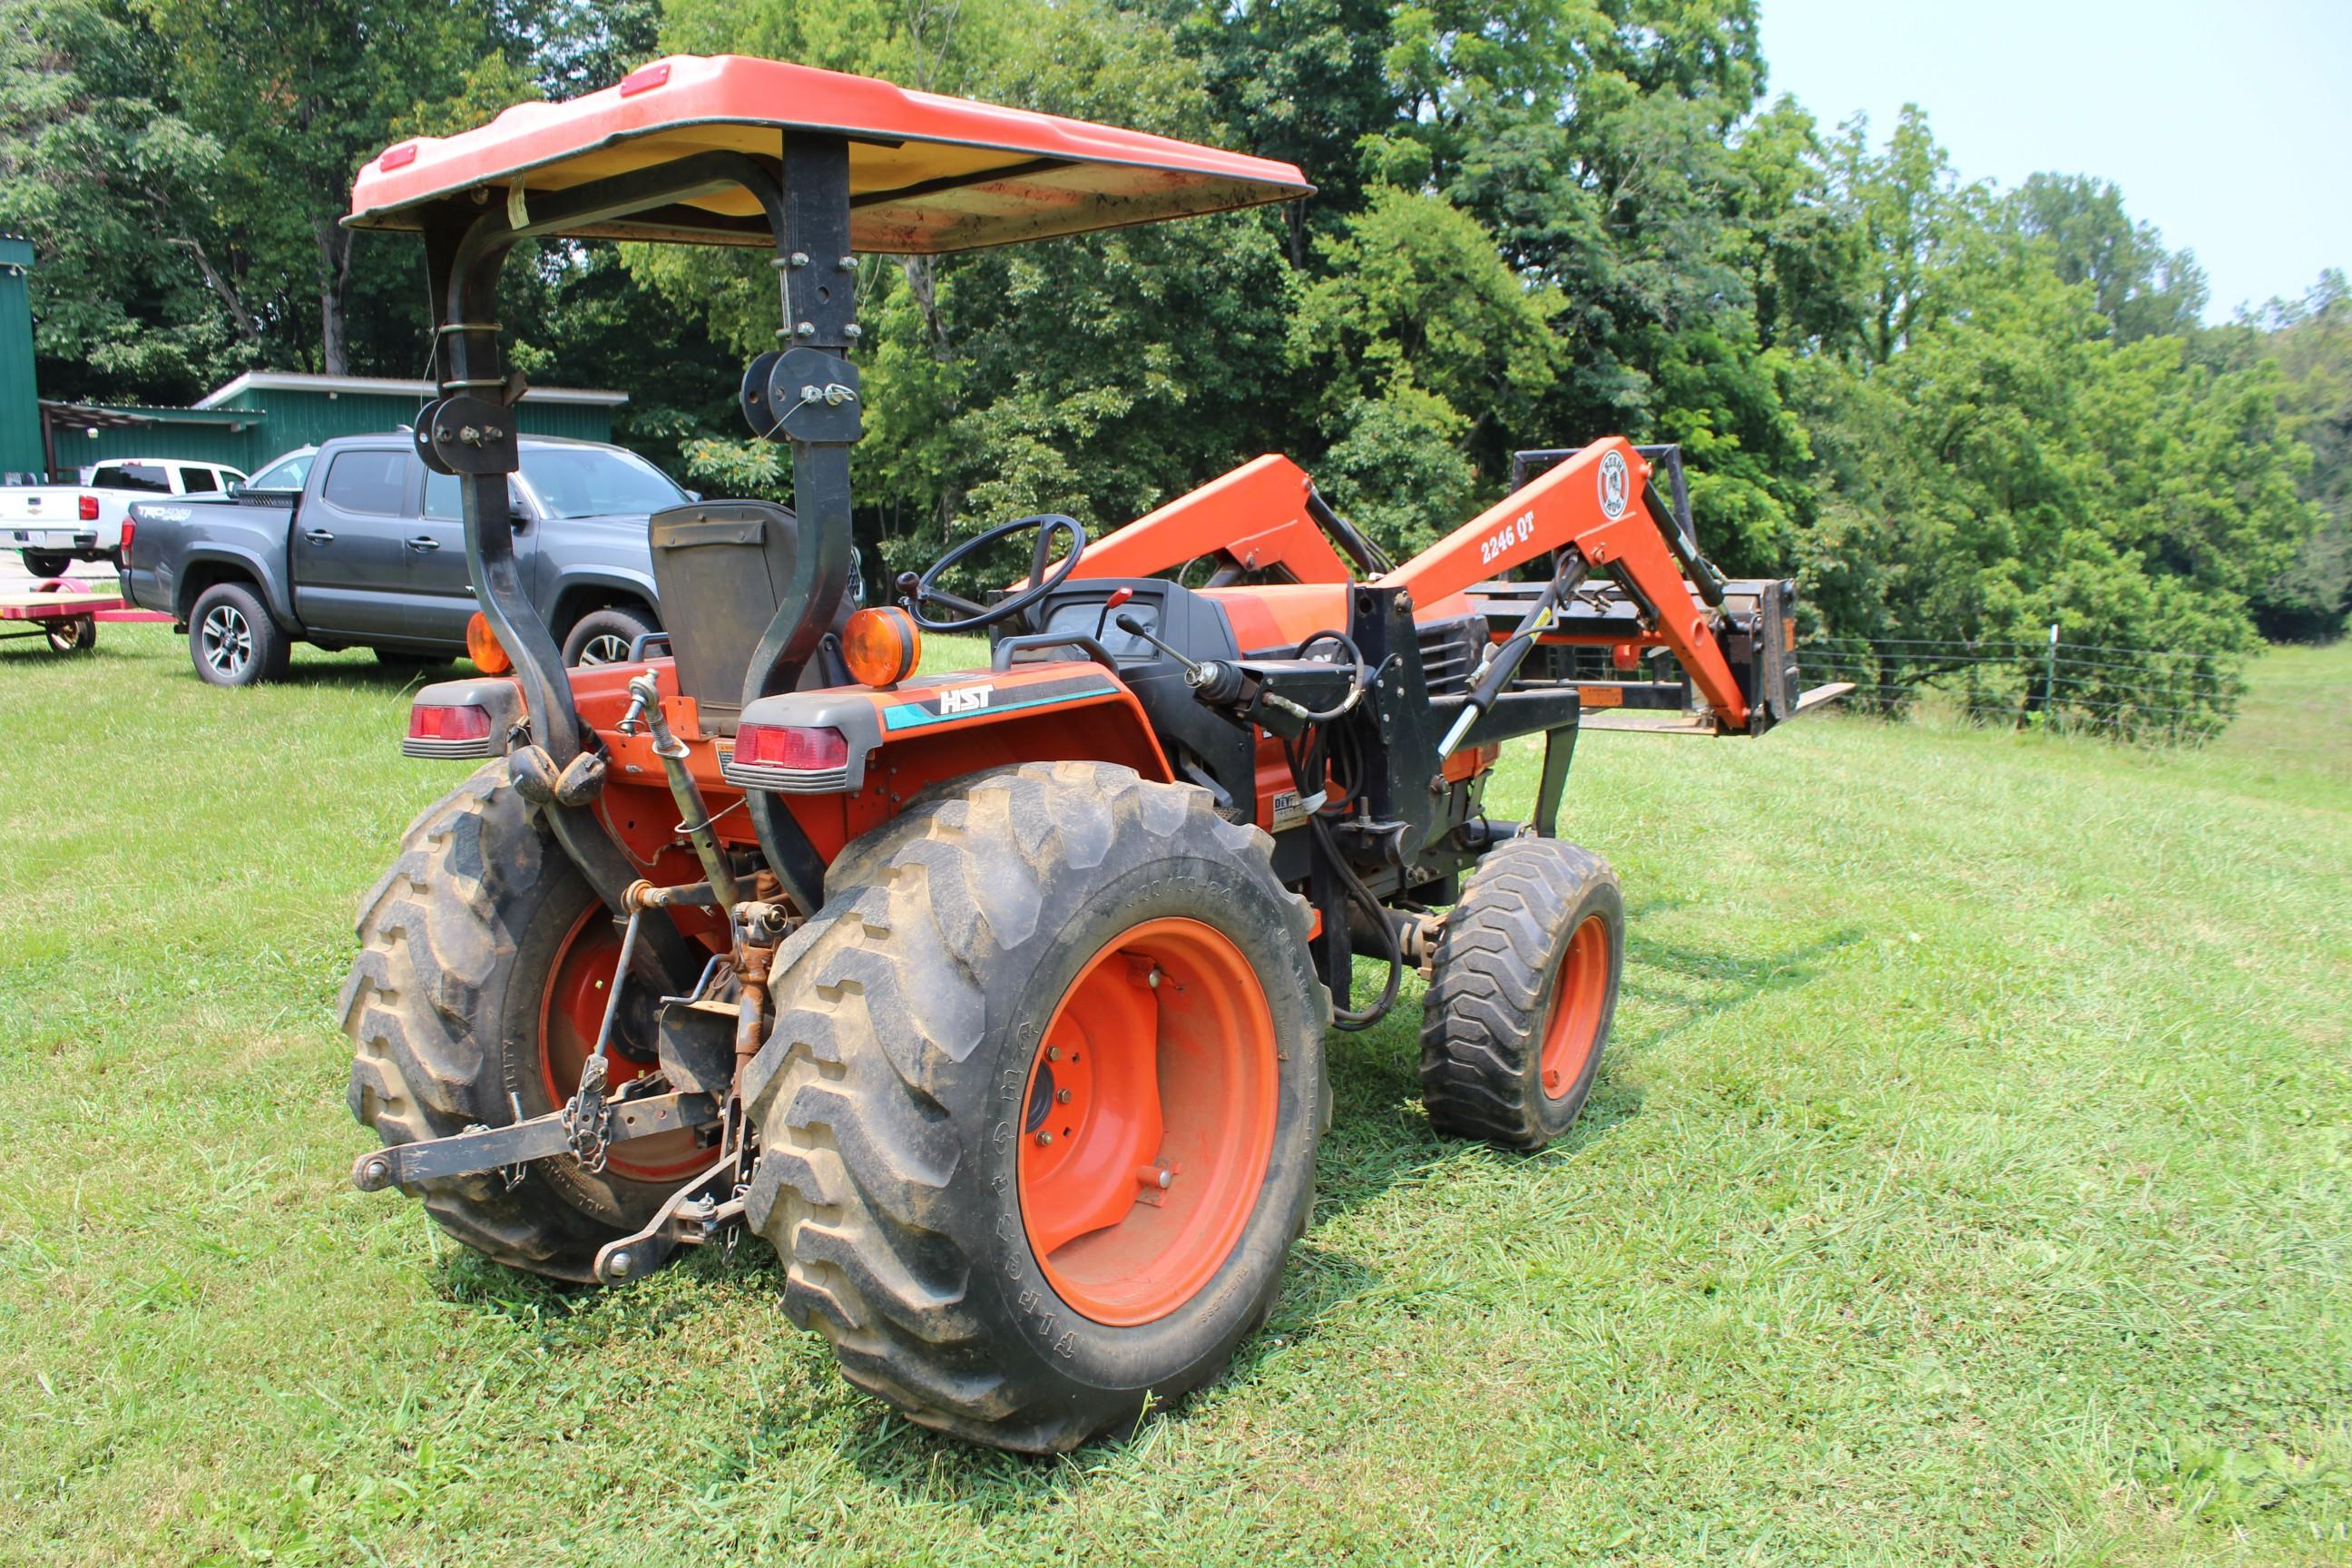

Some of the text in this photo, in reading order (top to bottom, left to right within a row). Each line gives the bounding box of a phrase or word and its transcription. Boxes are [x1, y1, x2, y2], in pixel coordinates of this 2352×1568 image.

[1606, 498, 1622, 513] HOG
[1481, 510, 1534, 565] 2246 QT
[940, 683, 995, 715] HST
[1200, 1268, 1249, 1323] TUBELESS
